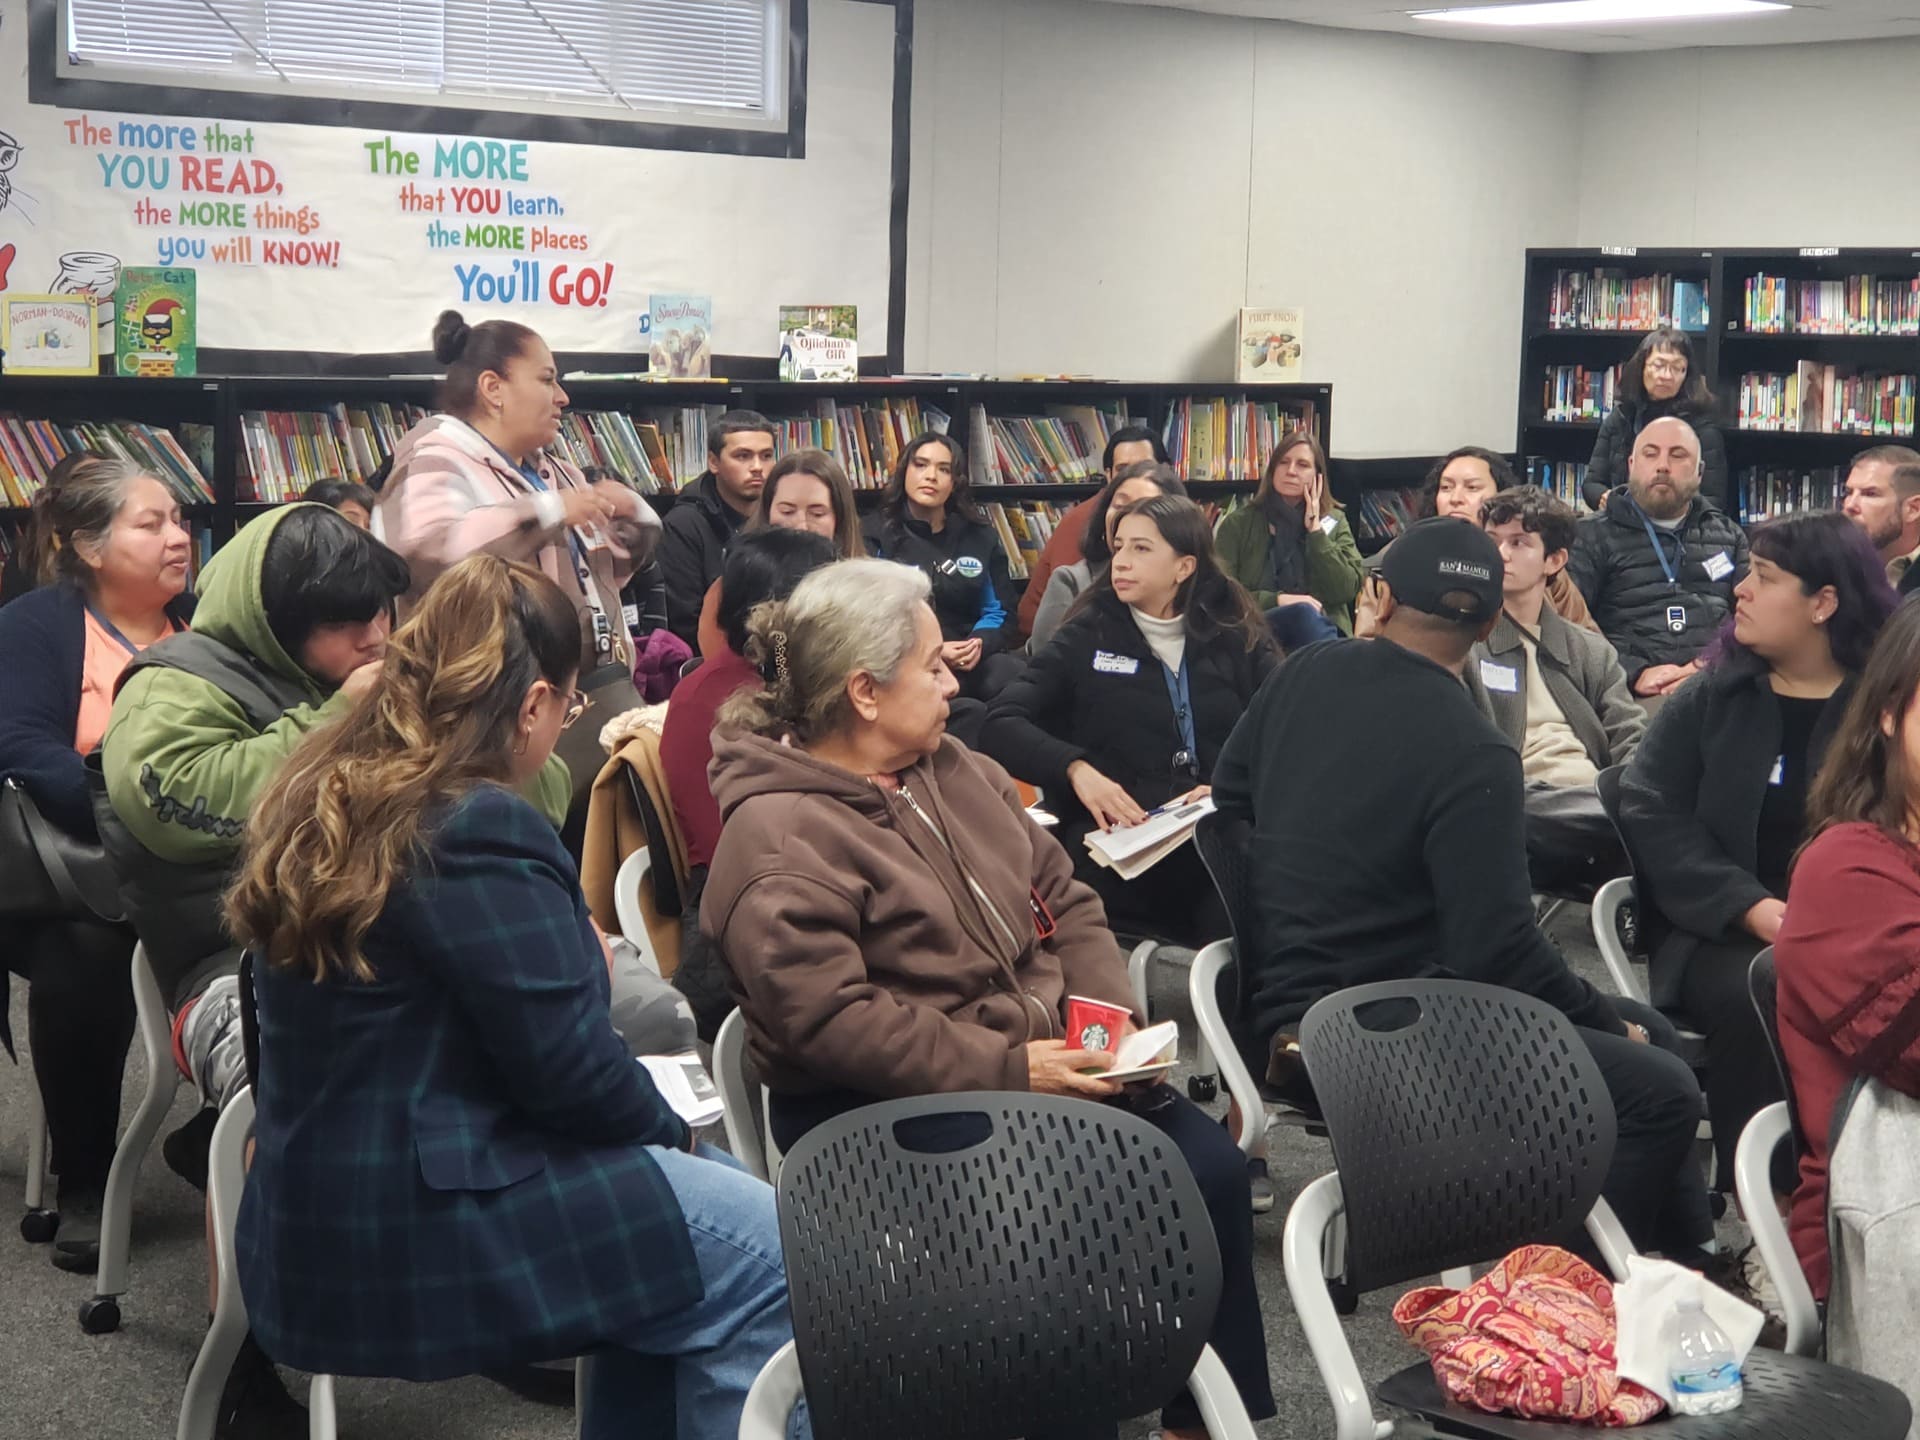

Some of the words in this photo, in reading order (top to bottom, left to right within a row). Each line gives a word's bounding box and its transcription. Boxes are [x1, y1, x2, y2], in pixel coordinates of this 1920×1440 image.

[64, 114, 112, 145] The
[119, 121, 196, 150] more
[203, 123, 254, 152] that
[97, 153, 170, 190] YOU
[179, 155, 283, 195] READ,
[364, 136, 420, 174] The
[433, 138, 529, 181] MORE
[134, 197, 171, 225] the
[179, 201, 247, 228] MORE
[253, 201, 320, 235] things
[399, 182, 445, 212] that
[451, 187, 501, 214] YOU
[507, 191, 564, 216] learn,
[158, 237, 206, 266] you
[211, 236, 252, 263] will
[263, 239, 340, 268] KNOW!
[426, 219, 461, 248] the
[465, 223, 525, 250] MORE
[531, 226, 588, 252] places
[163, 271, 186, 284] Cat
[454, 259, 540, 303] You'll
[549, 262, 614, 308] GO!
[12, 307, 47, 326] NORMAN
